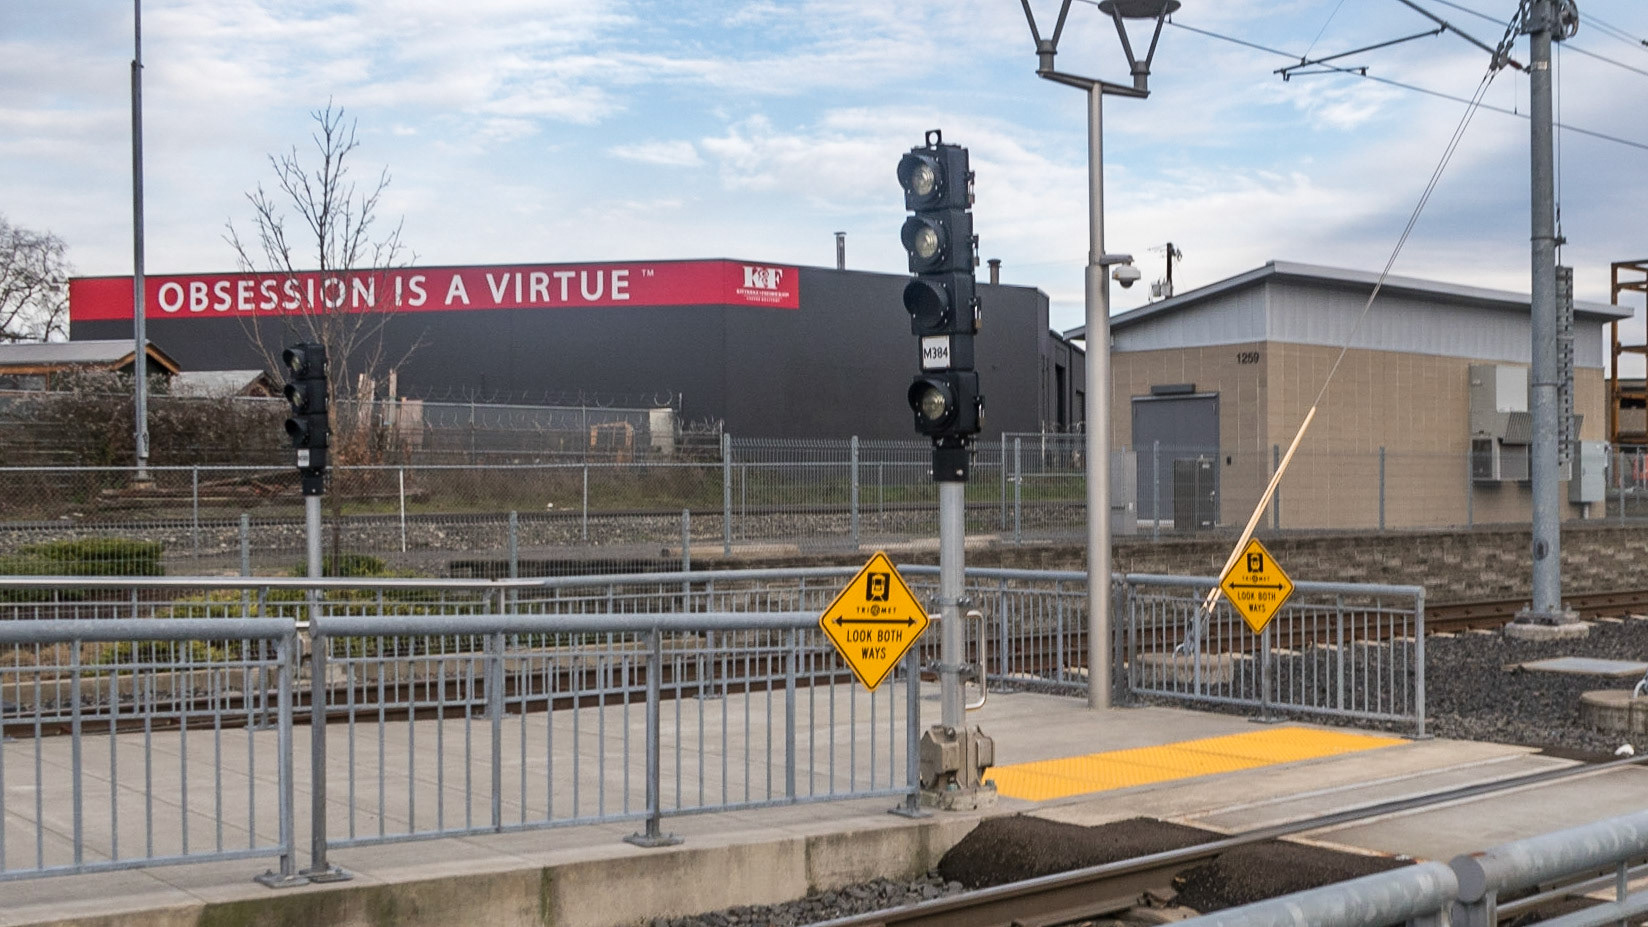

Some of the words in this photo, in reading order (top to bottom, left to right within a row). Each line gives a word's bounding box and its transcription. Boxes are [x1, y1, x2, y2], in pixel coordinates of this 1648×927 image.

[158, 276, 376, 313] OBSESSION
[394, 275, 428, 307] IS
[444, 274, 471, 305] A
[486, 269, 631, 305] VIRTUE
[923, 346, 949, 359] M384
[1237, 591, 1255, 601] LOOK
[1258, 592, 1276, 602] BOTH
[1249, 603, 1266, 613] WAYS
[846, 629, 872, 643] LOOK
[877, 629, 903, 643] BOTH
[861, 646, 886, 660] WAYS
